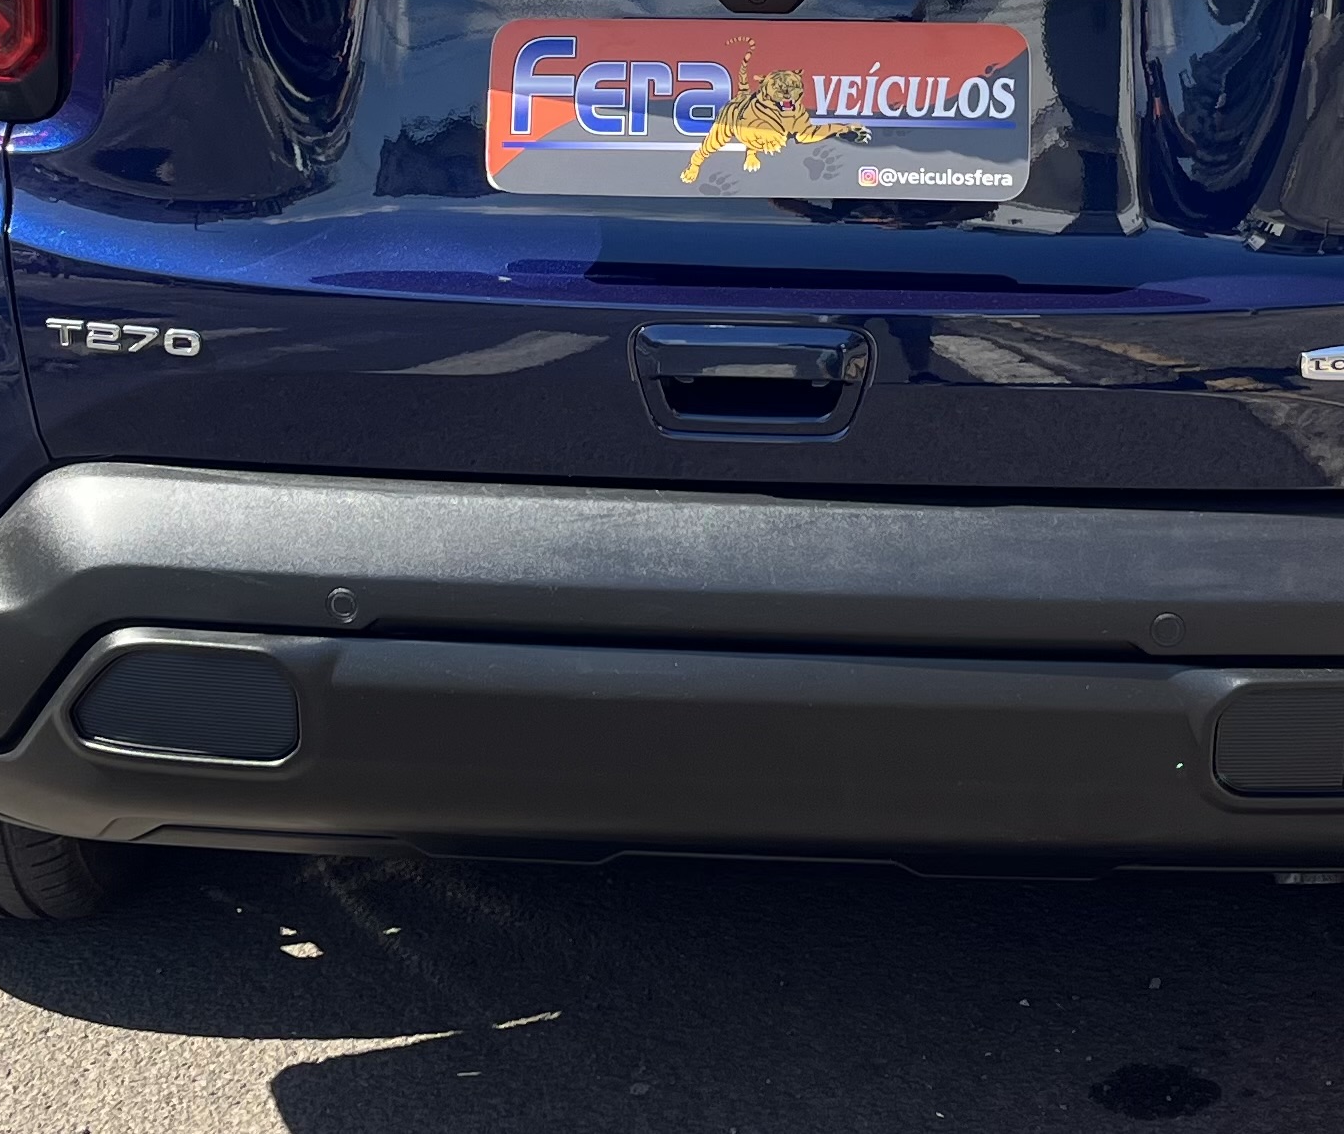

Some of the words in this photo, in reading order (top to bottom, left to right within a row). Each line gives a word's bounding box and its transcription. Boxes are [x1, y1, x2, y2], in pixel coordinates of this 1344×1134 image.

[812, 62, 1016, 120] VEÍCULOS
[878, 168, 1013, 187] @veiculosfera
[46, 318, 201, 357] T270
